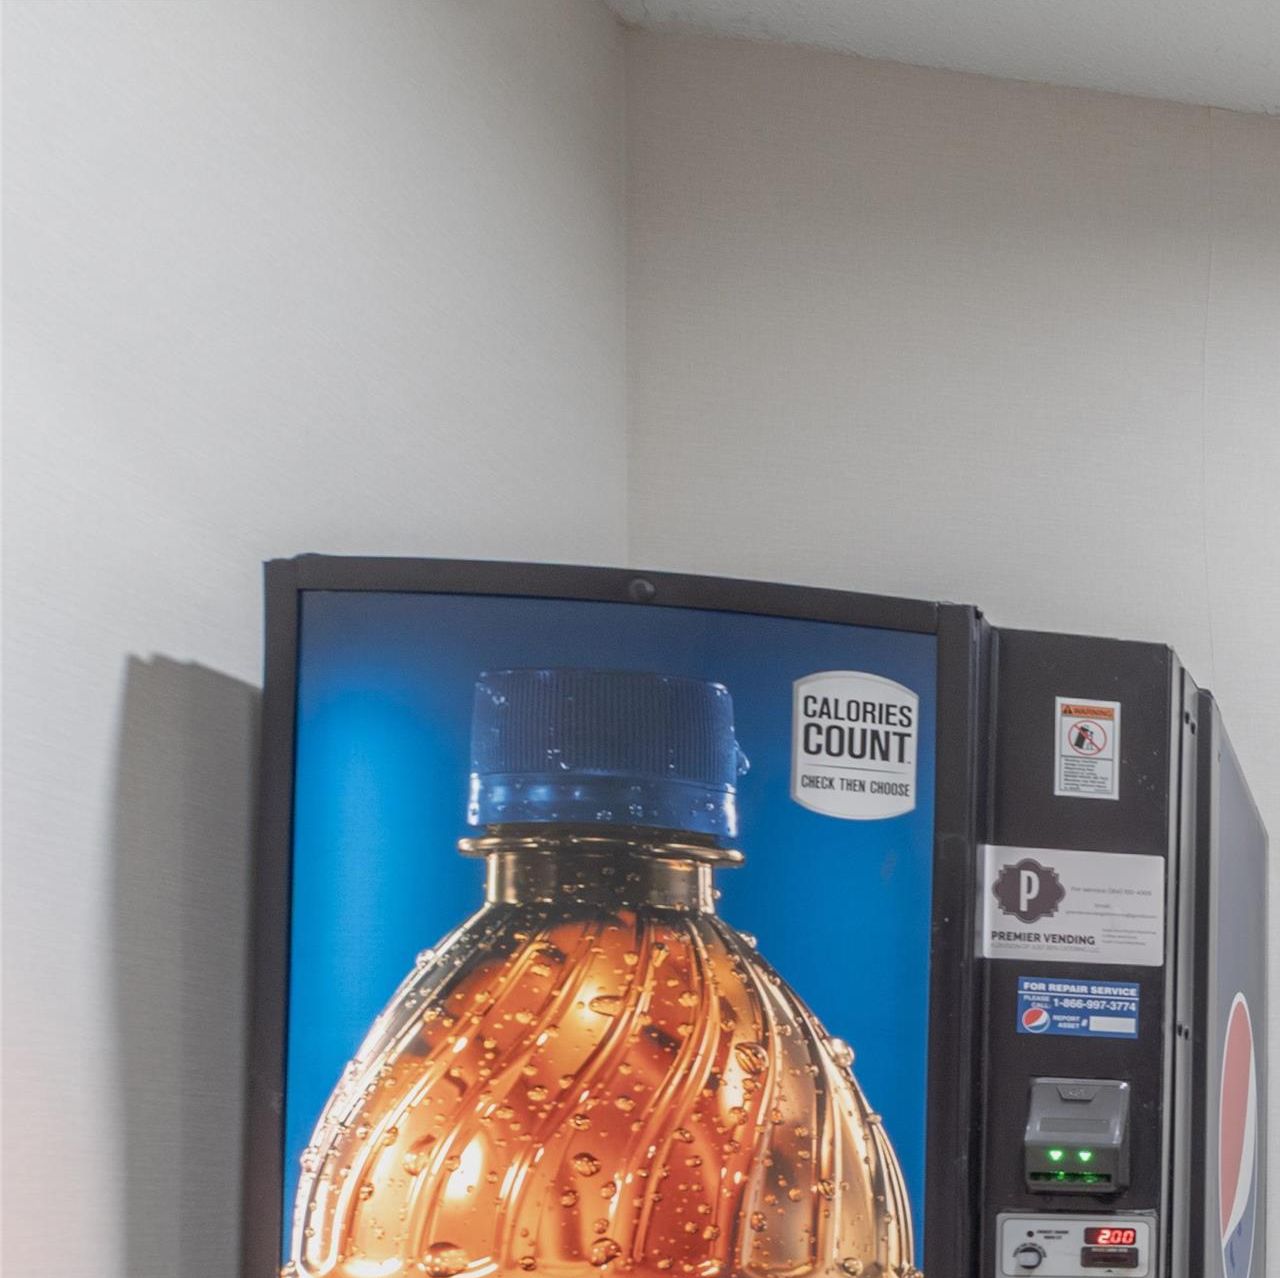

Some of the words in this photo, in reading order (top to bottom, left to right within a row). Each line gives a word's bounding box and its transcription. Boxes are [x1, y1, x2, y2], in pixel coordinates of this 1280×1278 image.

[803, 695, 912, 728] CALORIES
[803, 722, 912, 764] COUNT
[801, 774, 835, 791] CHECK
[840, 777, 866, 793] THEN
[870, 780, 910, 797] CHOOSE
[1019, 870, 1041, 912] P
[991, 930, 1041, 943] PREMIER
[1044, 933, 1096, 946] VENDING
[1023, 982, 1046, 991] FOR
[1048, 983, 1088, 993] REPAIR
[1091, 985, 1137, 996] SERVICE
